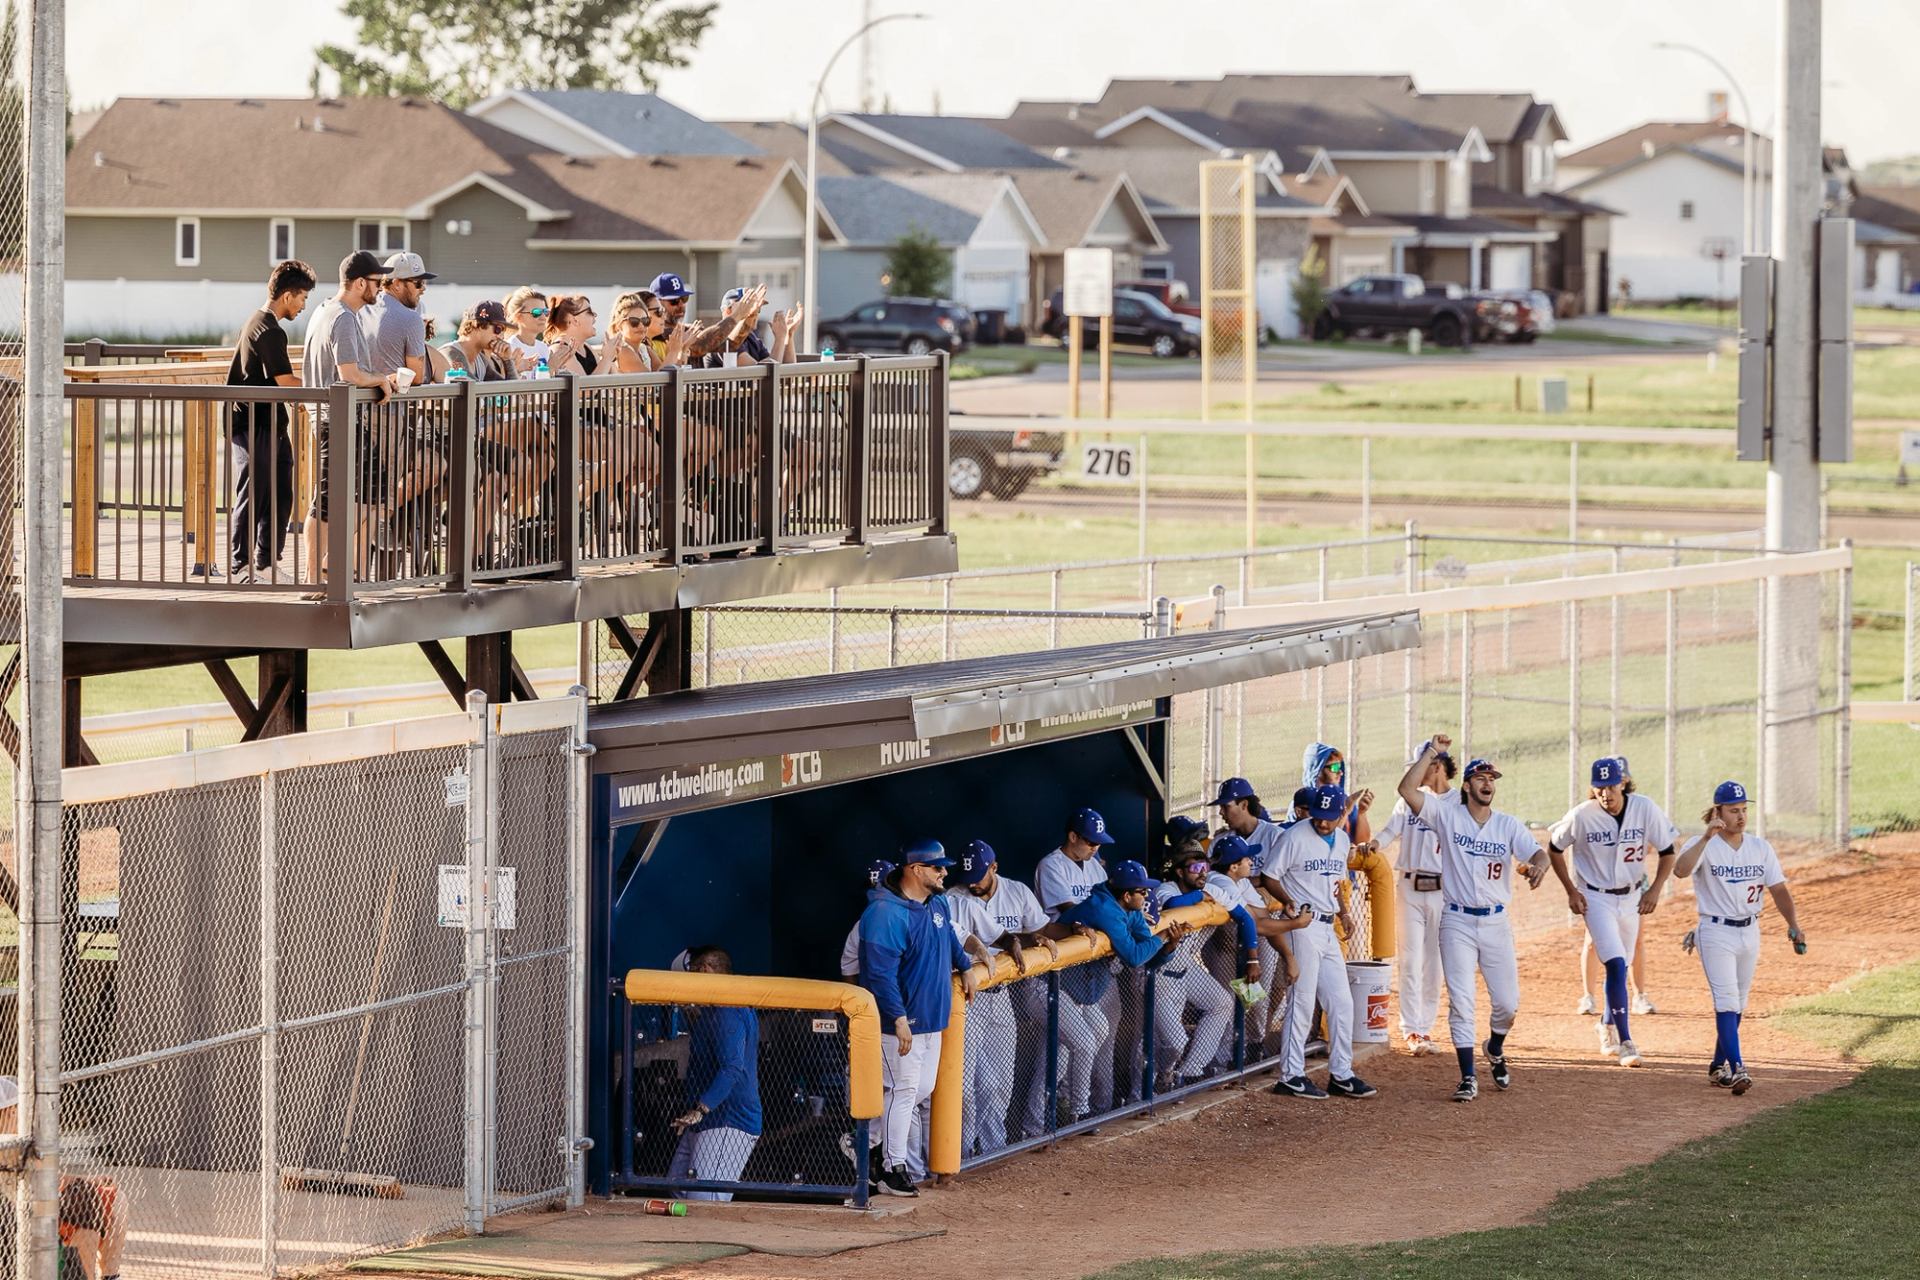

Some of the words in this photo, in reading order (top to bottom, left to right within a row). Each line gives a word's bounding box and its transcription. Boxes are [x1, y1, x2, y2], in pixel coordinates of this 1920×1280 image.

[670, 278, 681, 291] B
[1087, 448, 1131, 476] 276
[1600, 766, 1610, 780] B
[618, 760, 764, 808] www.tcbwelding.com
[1734, 785, 1744, 798] B
[1321, 796, 1332, 809] B
[1096, 819, 1105, 833] B
[1453, 831, 1506, 856] BOMBERS
[1623, 845, 1644, 862] 23
[963, 857, 972, 871] B
[1487, 862, 1503, 880] 19
[1711, 864, 1765, 878] BOMBERS
[1747, 884, 1764, 904] 27
